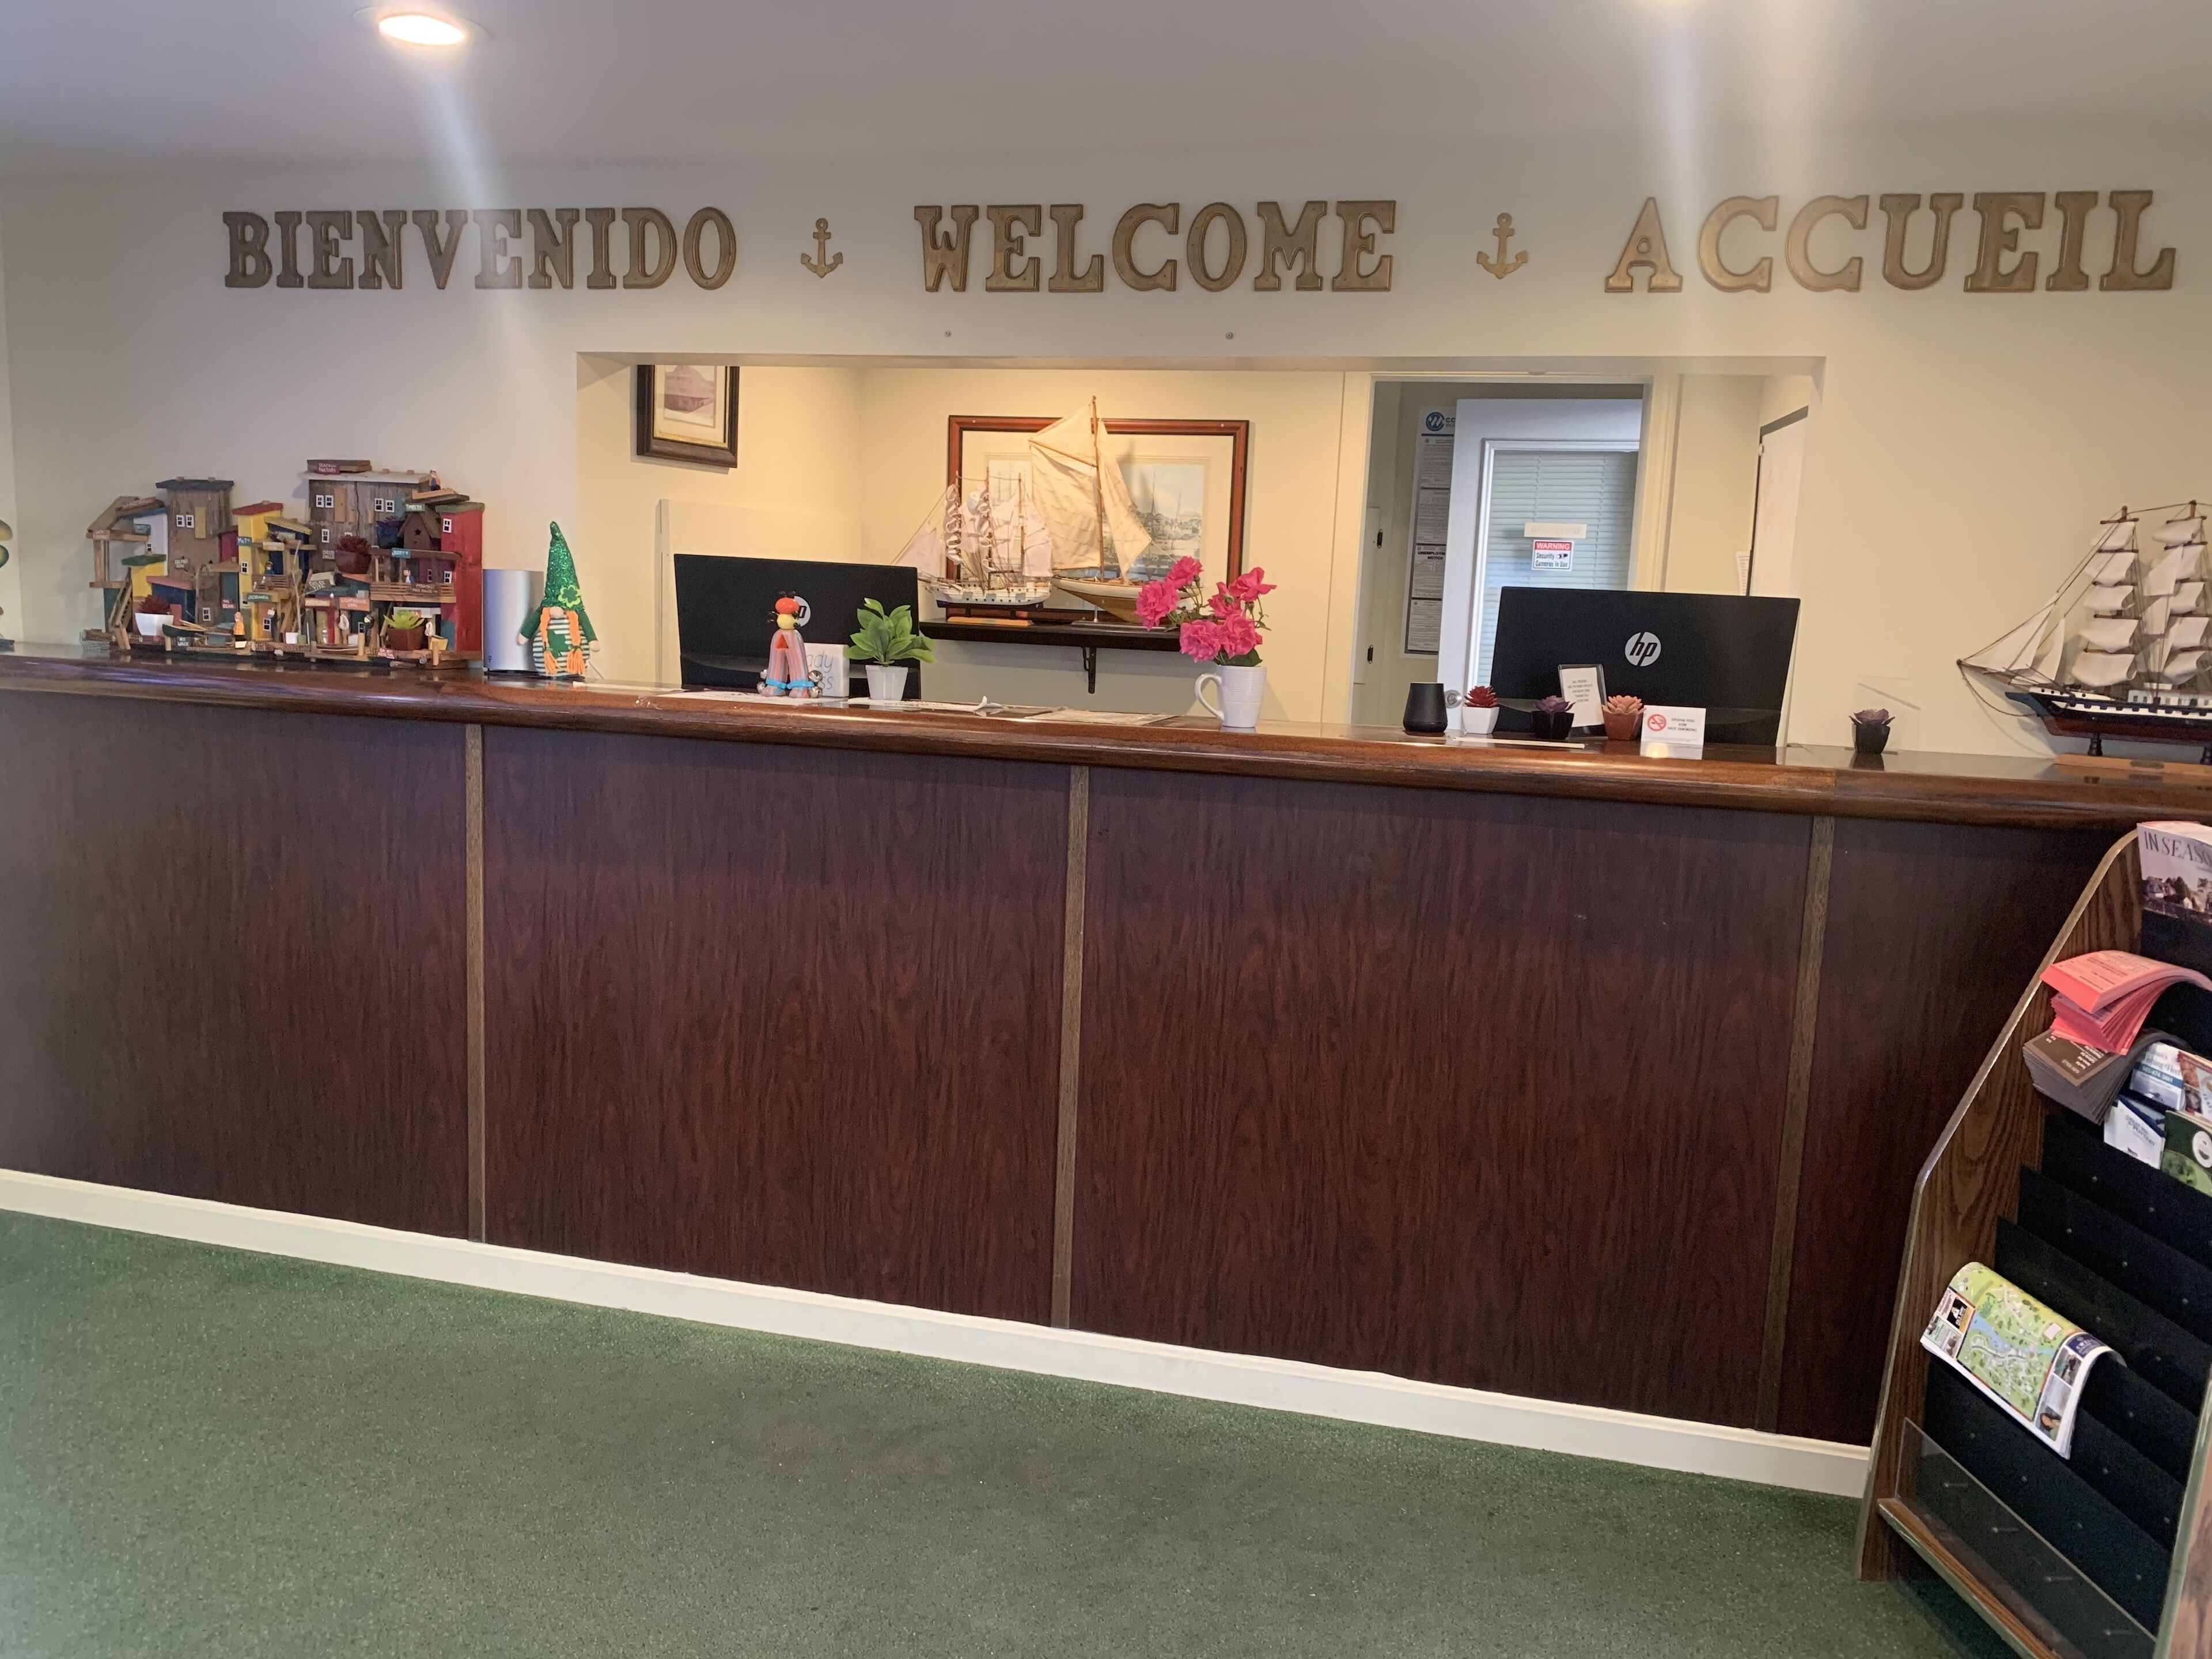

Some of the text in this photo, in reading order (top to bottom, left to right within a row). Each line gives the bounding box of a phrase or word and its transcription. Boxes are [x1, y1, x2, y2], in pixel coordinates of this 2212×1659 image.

[222, 190, 2176, 293] BIENVENIDO WELCOME ACCUEIL
[1536, 542, 1570, 550] WARNING
[806, 650, 834, 673] ady
[1627, 631, 1659, 666] hp
[2145, 831, 2212, 867] IN SEASO
